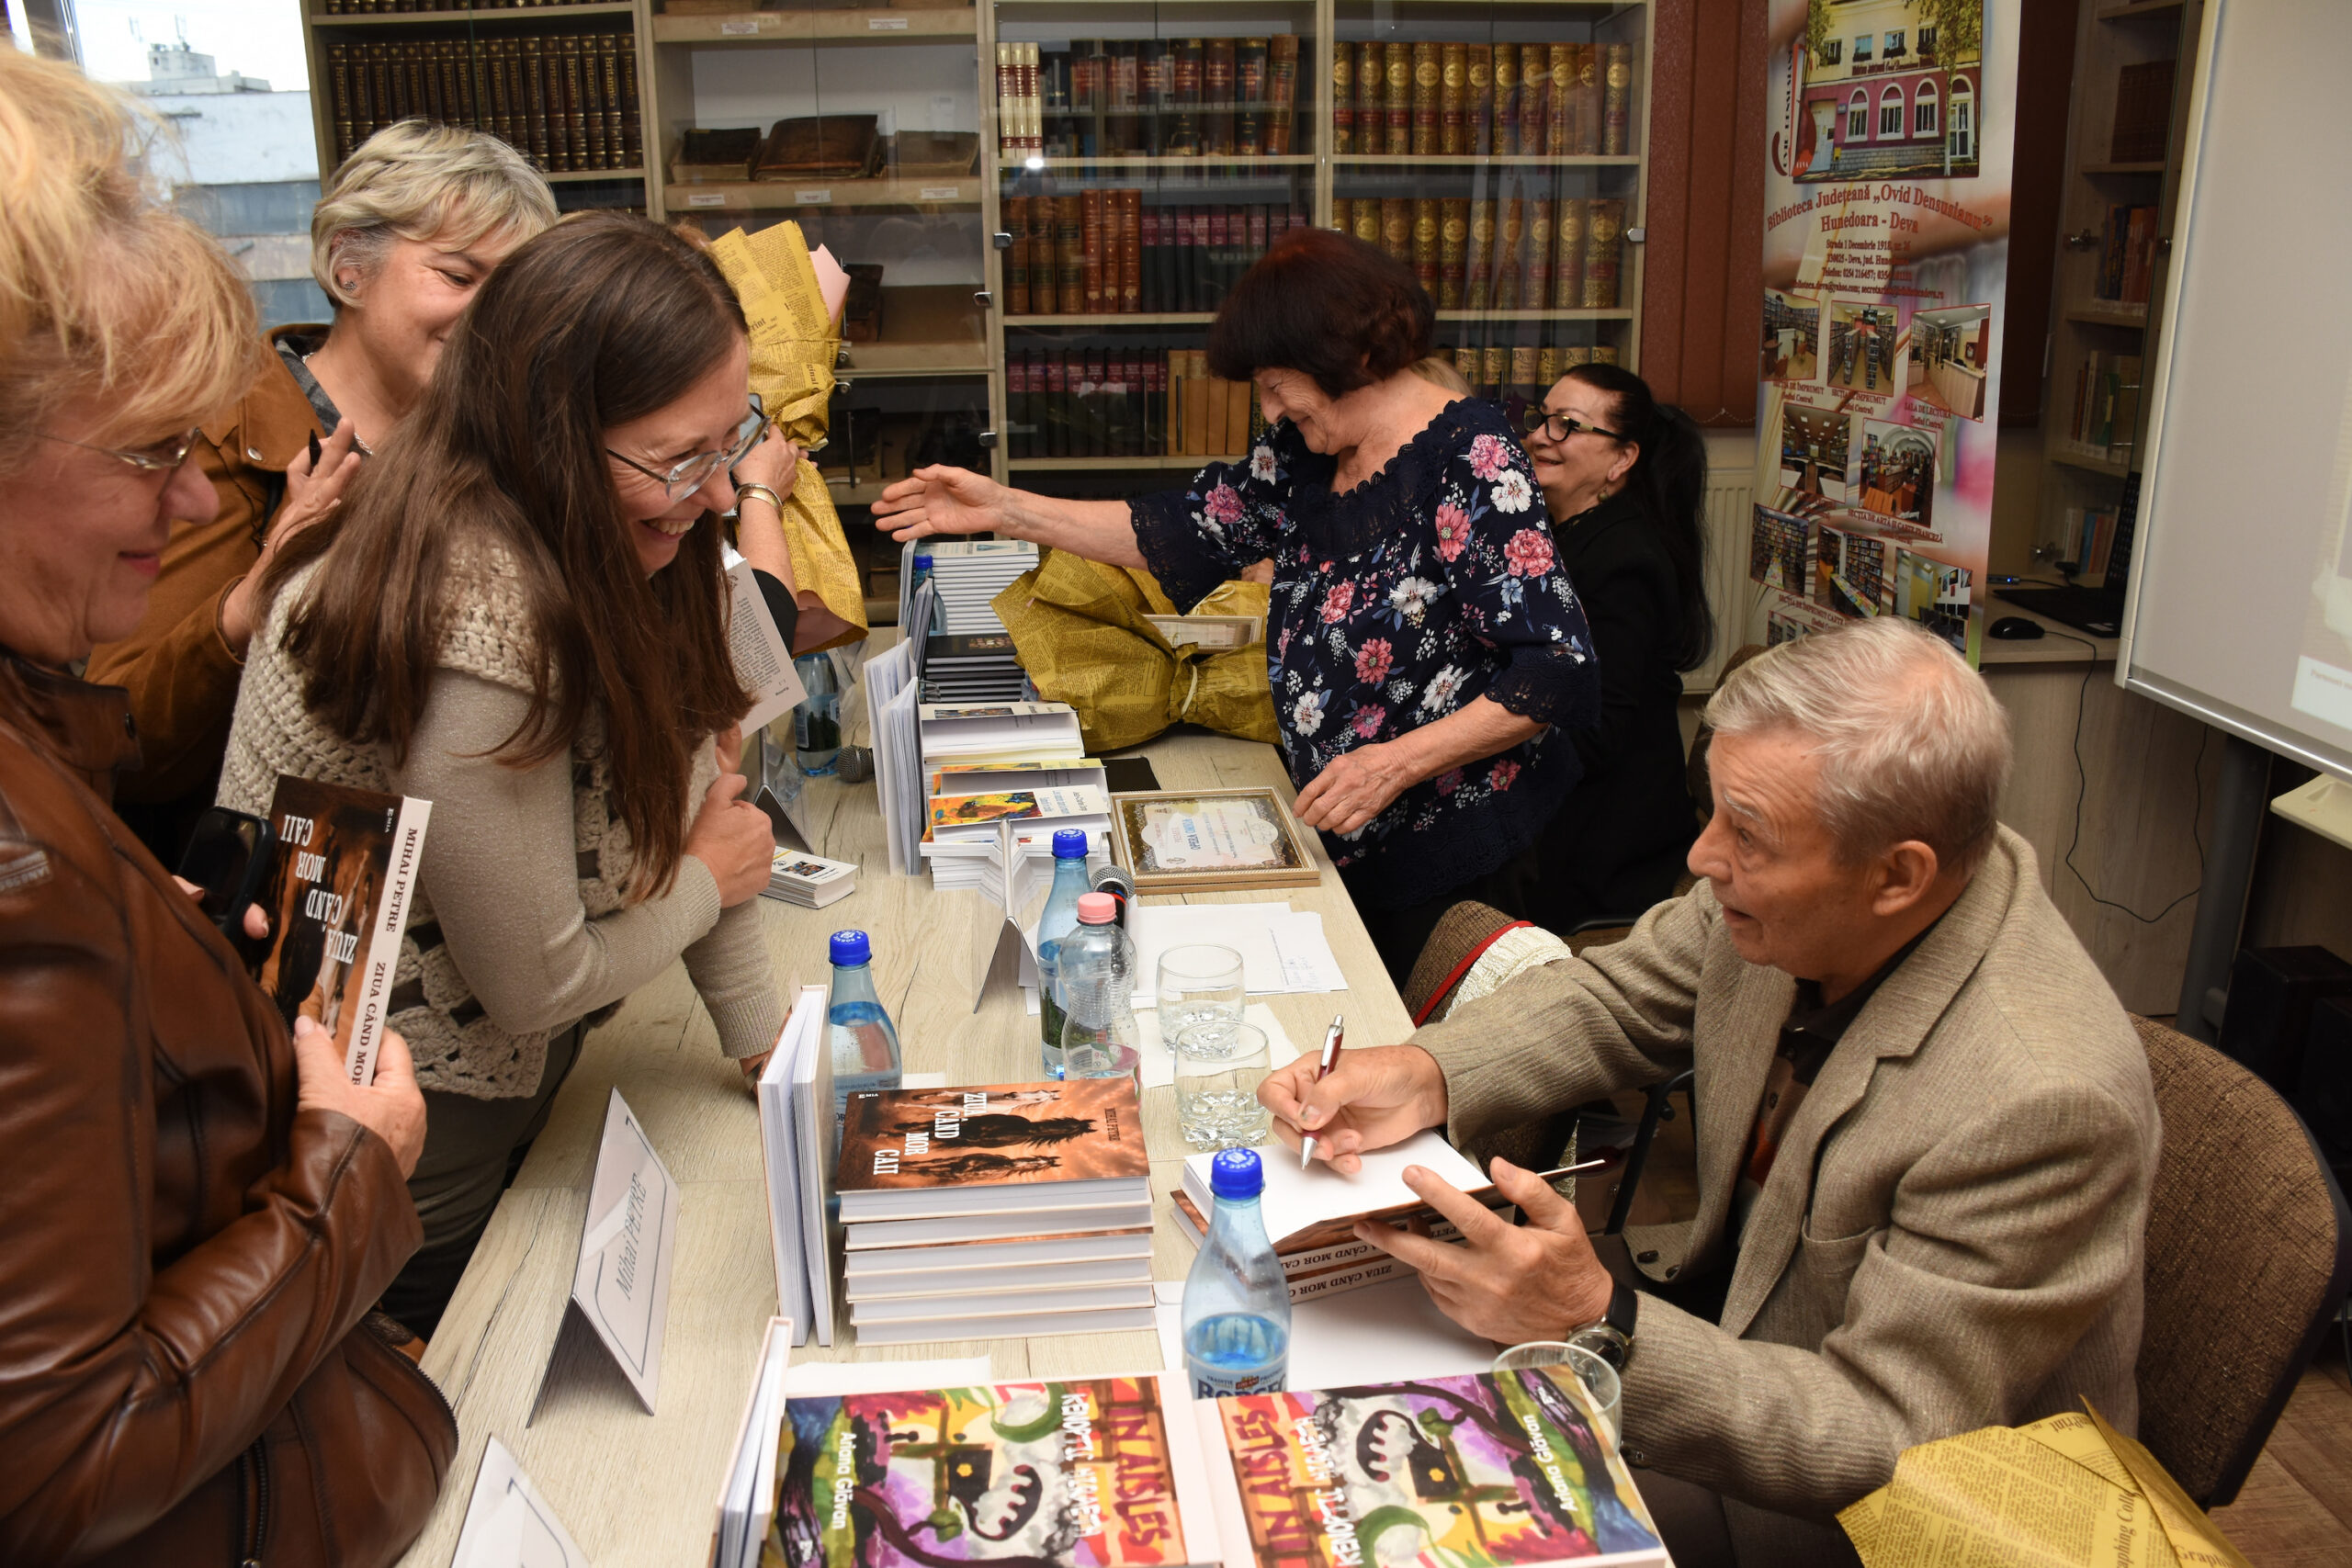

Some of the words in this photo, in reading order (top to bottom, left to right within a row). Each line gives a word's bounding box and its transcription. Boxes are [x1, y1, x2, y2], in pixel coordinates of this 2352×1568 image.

[335, 66, 347, 117] Britannica
[529, 60, 540, 110] Britannica
[567, 58, 579, 108] Britannica
[586, 57, 597, 107] Britannica
[605, 57, 616, 107] Britannica
[1767, 198, 1814, 232] Biblioteca
[1821, 211, 1879, 232] Hunedoara
[1889, 211, 1918, 233] Deva
[1849, 240, 1876, 250] Decembrie
[280, 814, 314, 847] CAII
[1187, 833, 1201, 851] OPERA
[295, 851, 326, 883] MOR
[399, 828, 418, 879] MIHAI
[306, 888, 343, 933] CÂND
[386, 880, 407, 933] PETRE
[325, 928, 358, 964] ZIUA
[369, 961, 386, 998] ZIUA
[359, 1001, 379, 1047] CÂND
[963, 1091, 988, 1118] ZIUA
[934, 1110, 967, 1140] CÂND
[873, 1148, 900, 1176] CAII
[904, 1132, 930, 1156] MOR
[625, 1172, 647, 1245] PETRE
[1430, 1225, 1458, 1238] PET
[616, 1234, 638, 1302] Mihai
[1281, 1259, 1300, 1269] CAI
[1304, 1252, 1331, 1265] MOR
[1335, 1245, 1368, 1259] CÂND
[1299, 1280, 1327, 1294] MOR
[1331, 1272, 1363, 1287] CÂND
[1366, 1264, 1393, 1279] ZIUA
[1108, 1408, 1155, 1441] IN
[1523, 1414, 1555, 1463] Glăvan
[836, 1431, 857, 1479] Ariana
[1232, 1409, 1291, 1497] AISLES
[831, 1479, 854, 1530] Glăvan
[1114, 1454, 1172, 1548] AISLES
[1538, 1463, 1578, 1513] Ariana
[1260, 1508, 1313, 1551] IN
